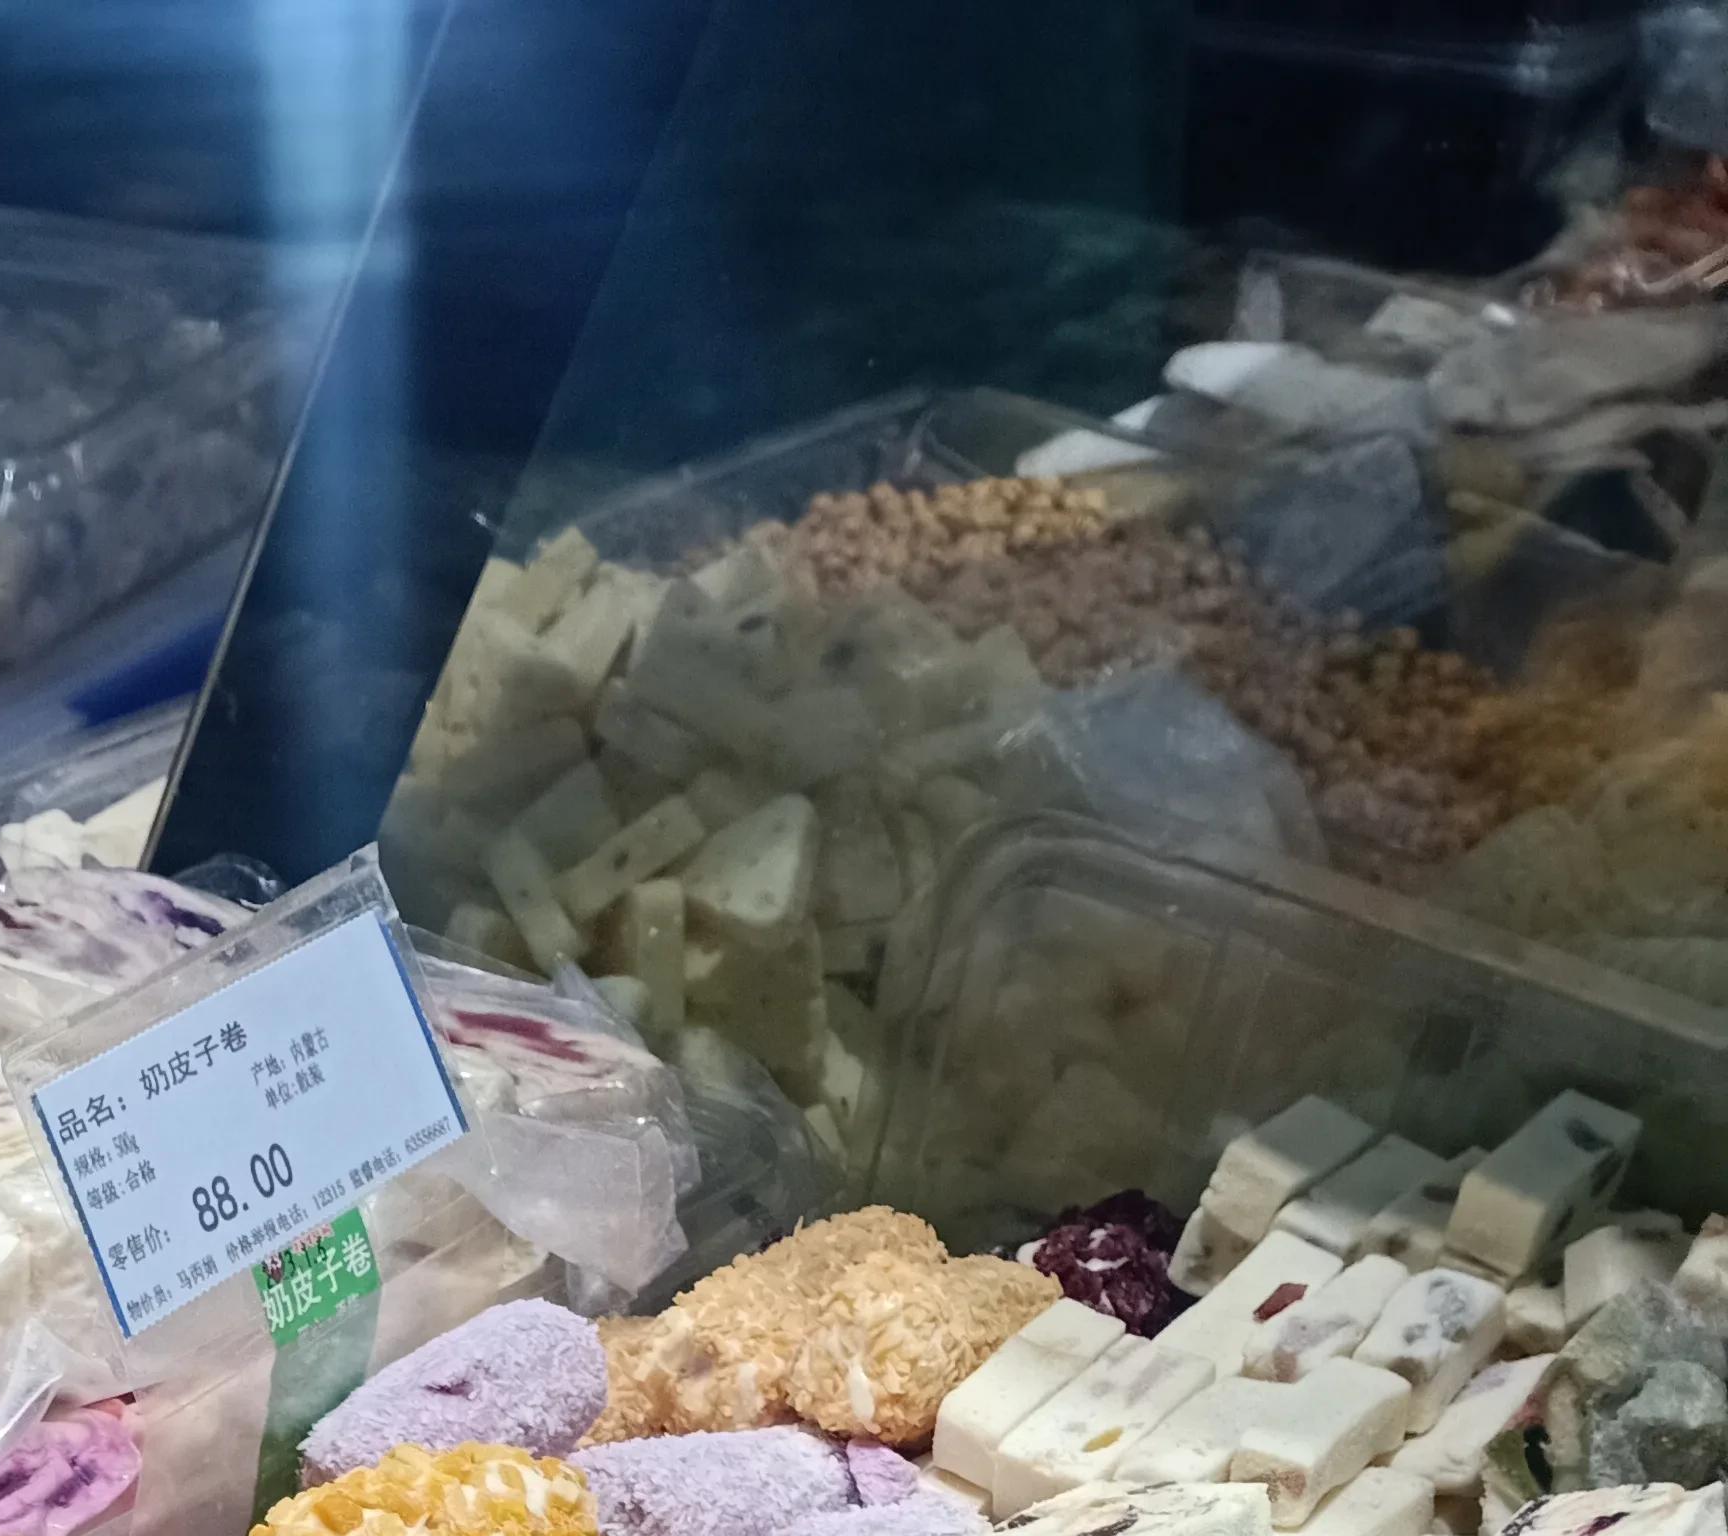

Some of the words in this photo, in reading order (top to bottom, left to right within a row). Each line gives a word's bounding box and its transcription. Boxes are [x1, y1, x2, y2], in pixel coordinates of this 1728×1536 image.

[192, 1143, 293, 1233] 88.00
[263, 1233, 371, 1332] 奶皮子卷
